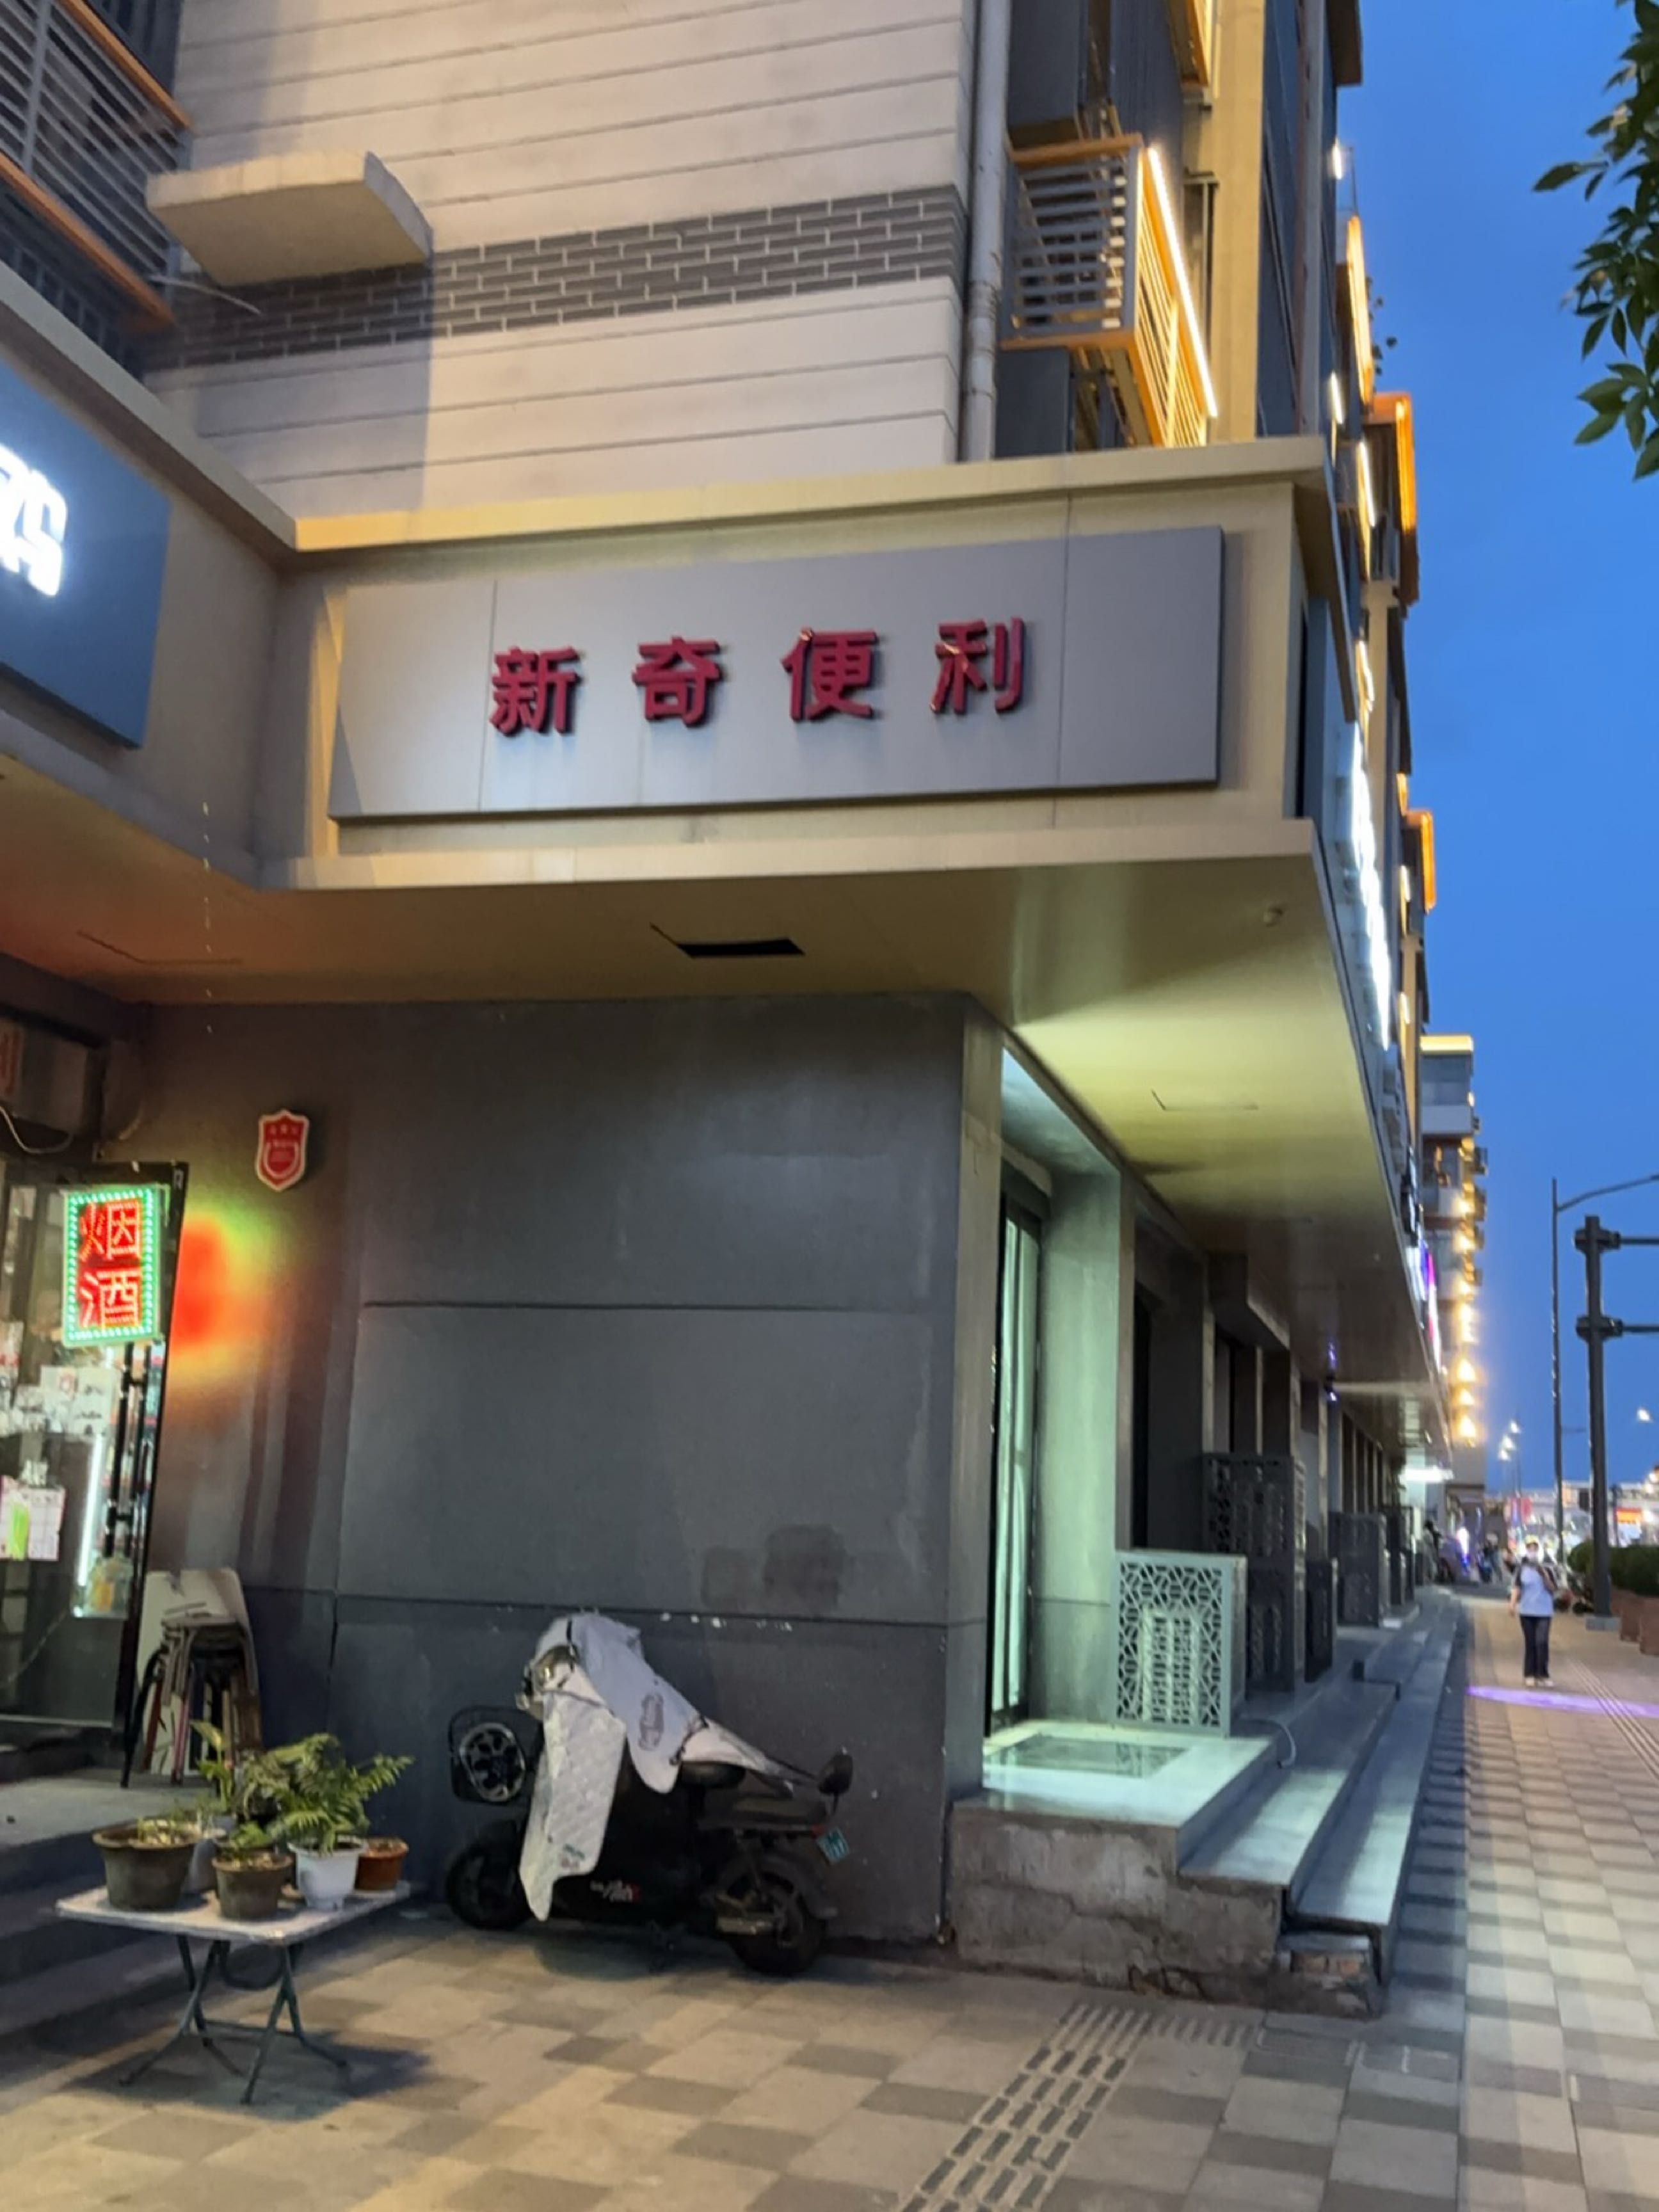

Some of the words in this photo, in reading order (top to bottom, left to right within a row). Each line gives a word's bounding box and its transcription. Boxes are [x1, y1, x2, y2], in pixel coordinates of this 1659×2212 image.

[490, 616, 1025, 735] 新奇便利
[79, 1198, 142, 1330] 烟酒
